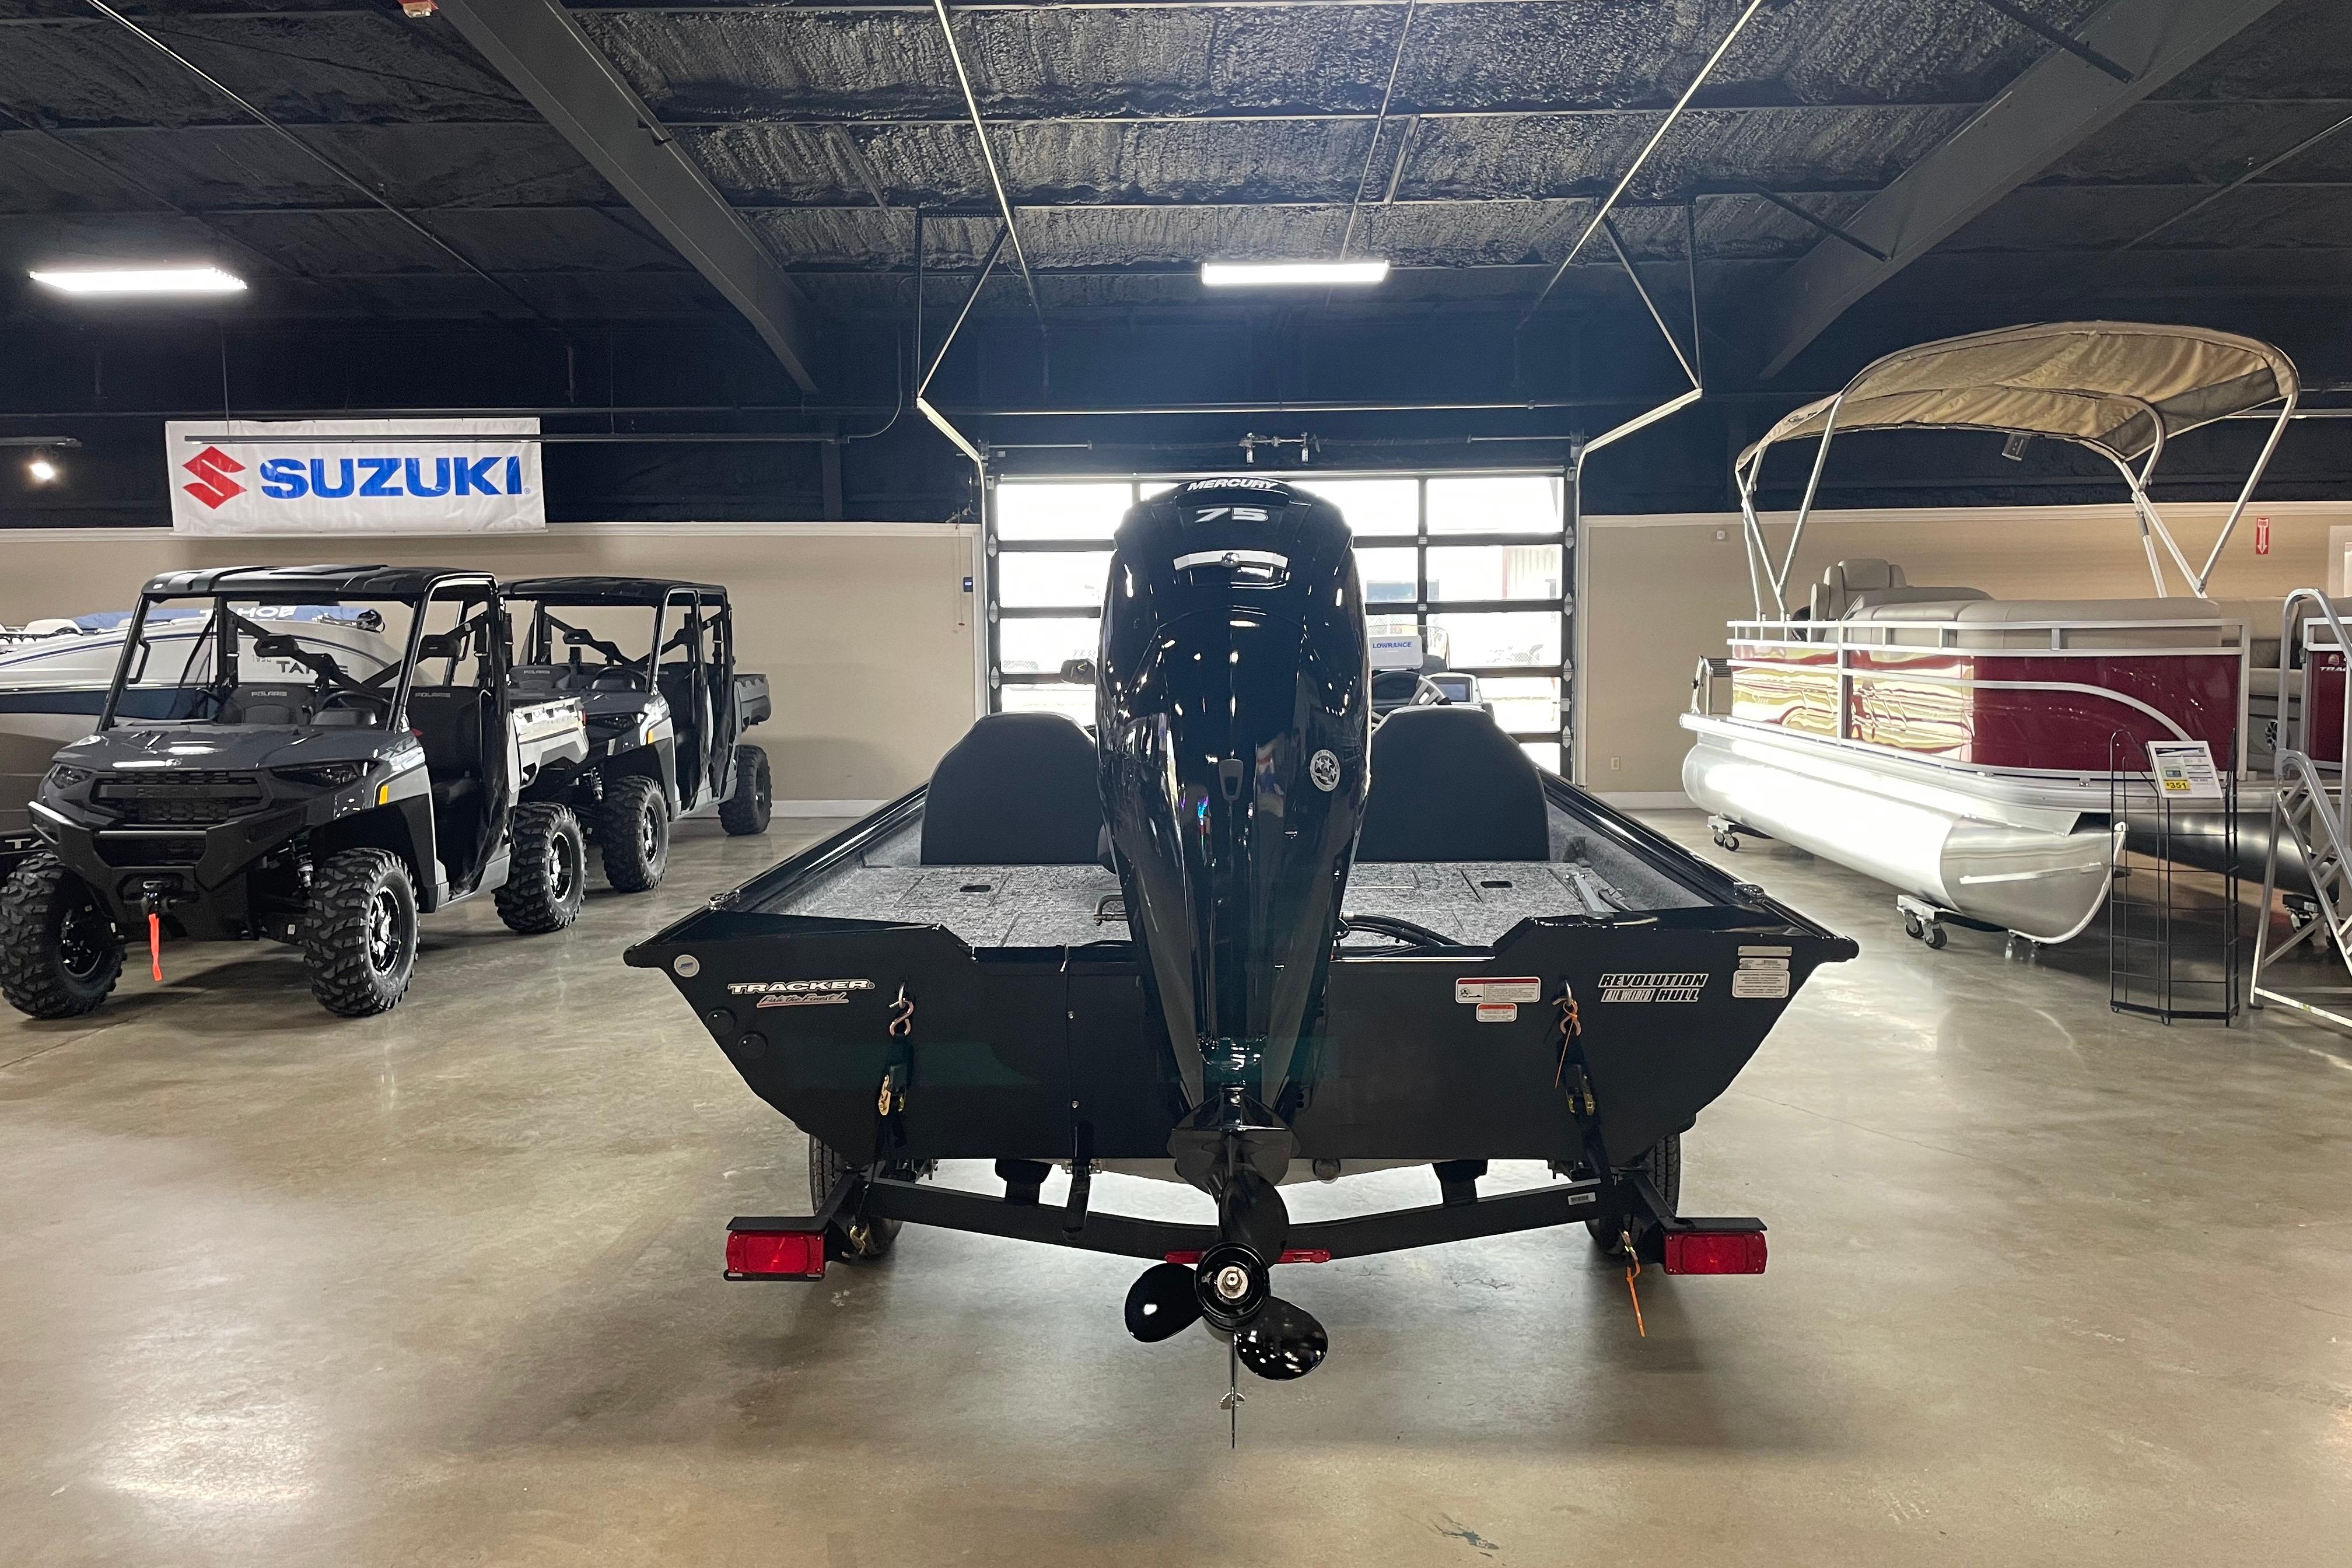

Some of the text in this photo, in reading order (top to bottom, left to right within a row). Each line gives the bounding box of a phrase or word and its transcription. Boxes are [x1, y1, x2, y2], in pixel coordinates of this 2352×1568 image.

[260, 456, 522, 498] SUZUKI
[1186, 479, 1278, 491] MERCURY
[1194, 508, 1269, 523] 75
[200, 606, 298, 620] THOE
[730, 980, 869, 993] TRACKER
[1600, 975, 1707, 986] REVOLUTION
[1657, 989, 1699, 1000] HULL
